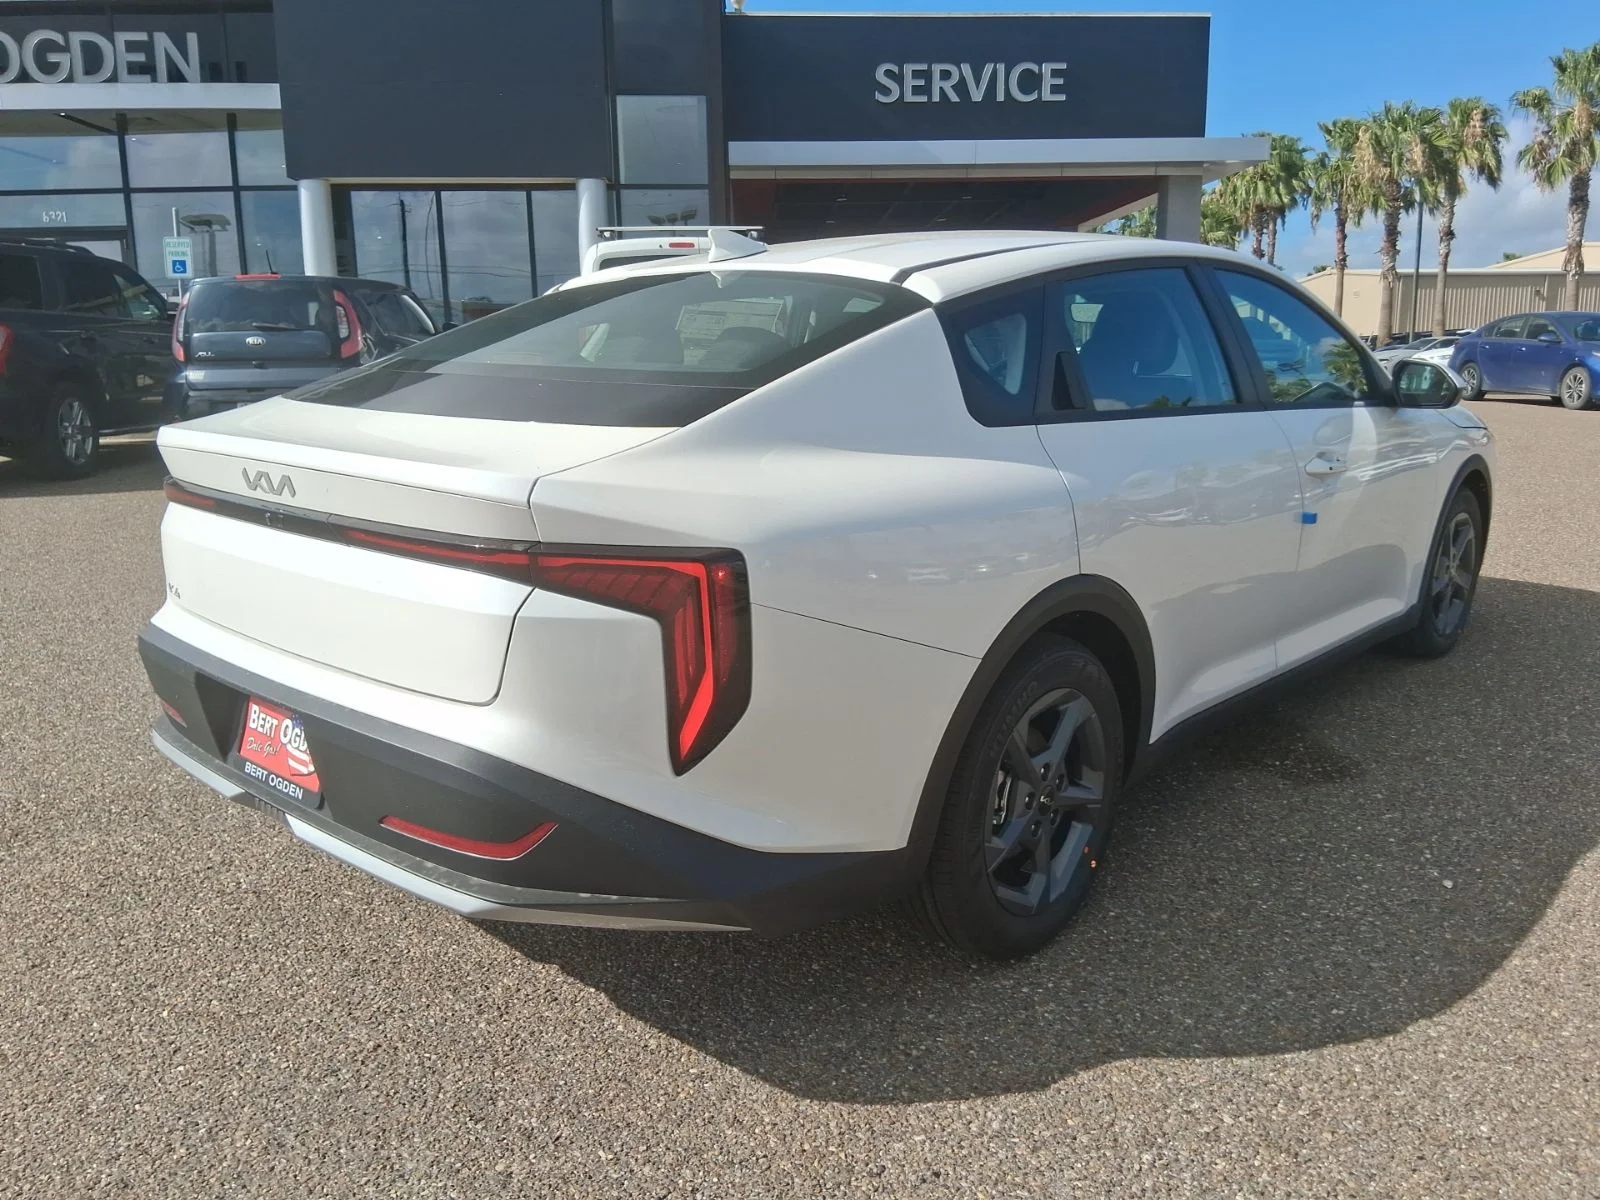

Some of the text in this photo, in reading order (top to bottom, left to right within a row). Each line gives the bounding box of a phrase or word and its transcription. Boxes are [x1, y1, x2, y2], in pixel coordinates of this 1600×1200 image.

[874, 61, 1068, 104] SERVICE
[249, 703, 310, 752] BERT OGD
[244, 761, 304, 800] BERT OGDEN
